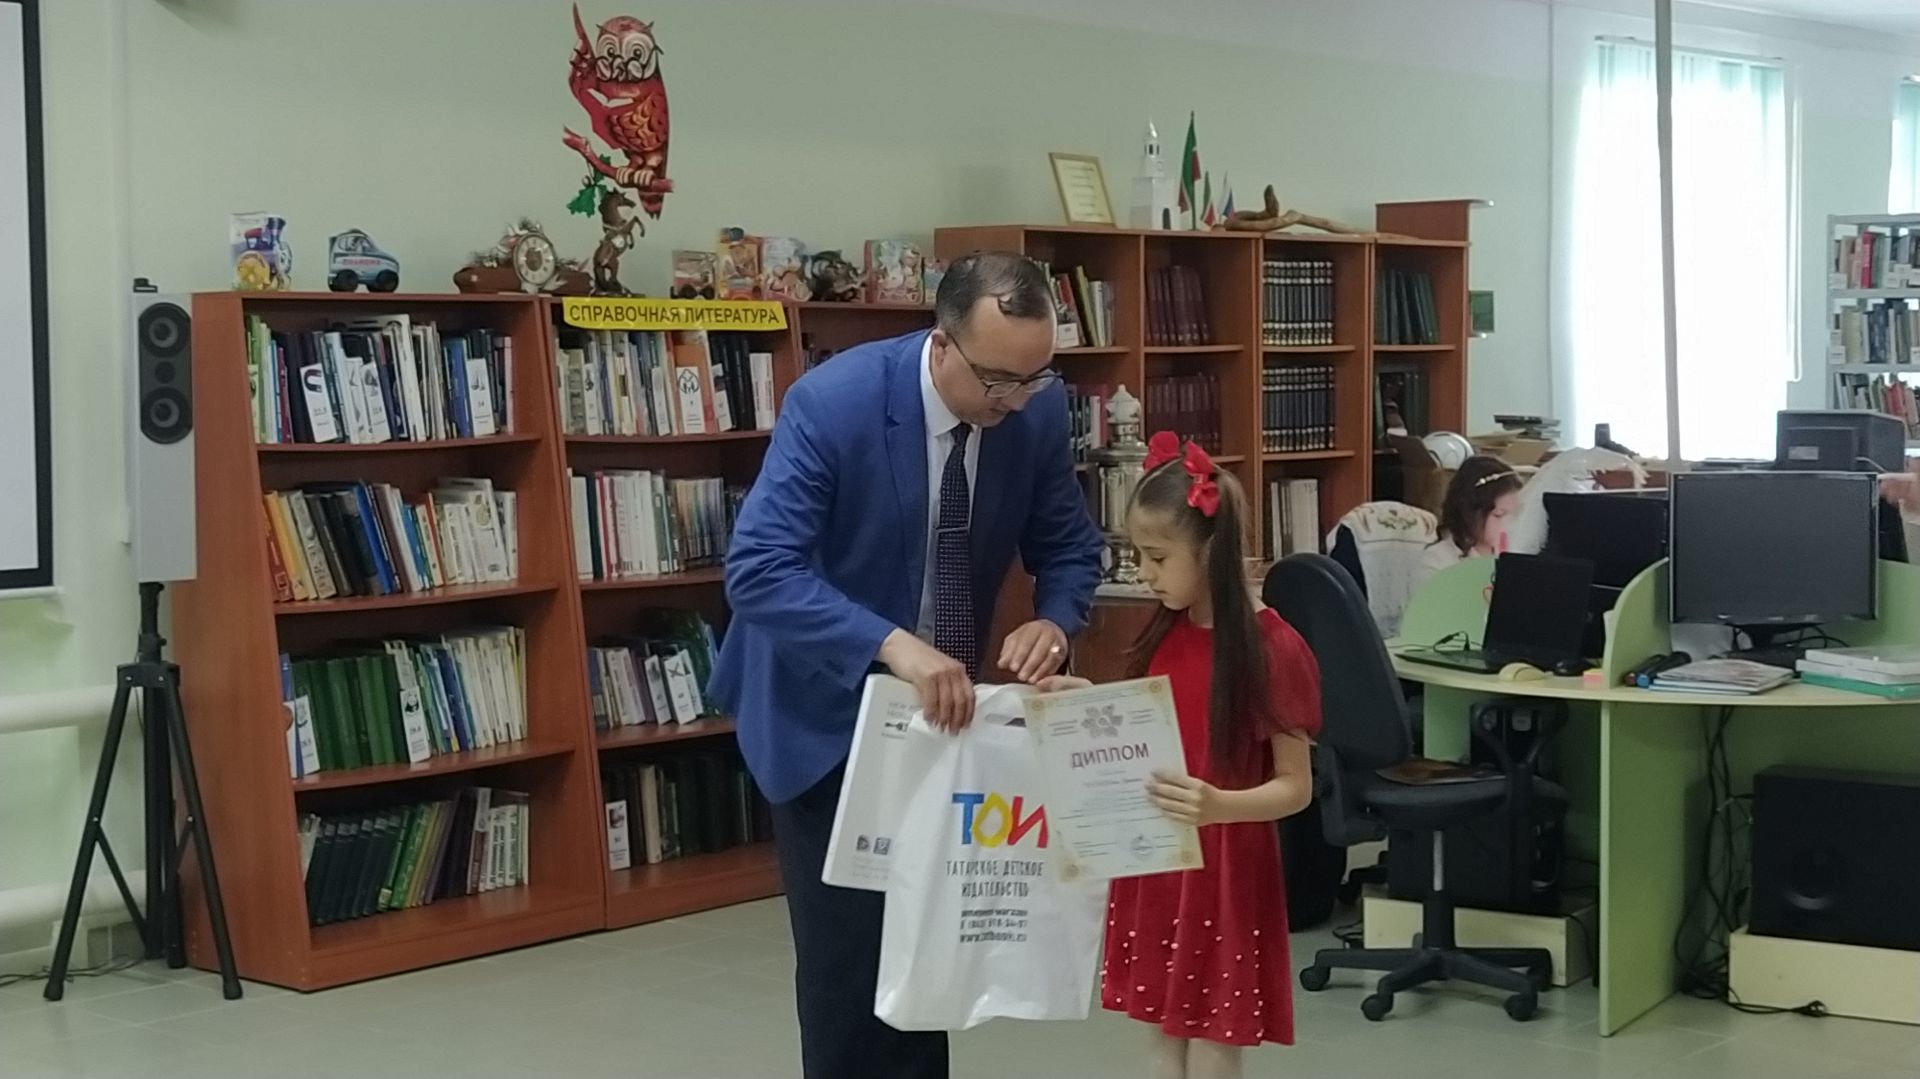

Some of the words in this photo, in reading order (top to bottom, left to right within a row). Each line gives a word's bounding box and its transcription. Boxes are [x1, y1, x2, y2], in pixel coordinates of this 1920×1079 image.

[569, 305, 680, 322] СПРАВОЧНАЯ
[685, 308, 780, 324] ЛИТЕРАТУРА
[1071, 742, 1149, 769] ДИПЛОМ
[946, 860, 998, 876] ТАТАРСКОЕ
[1002, 860, 1043, 876] ДЕТСКОЕ
[961, 881, 1028, 898] ИЗДАТЕЛЬСТВО
